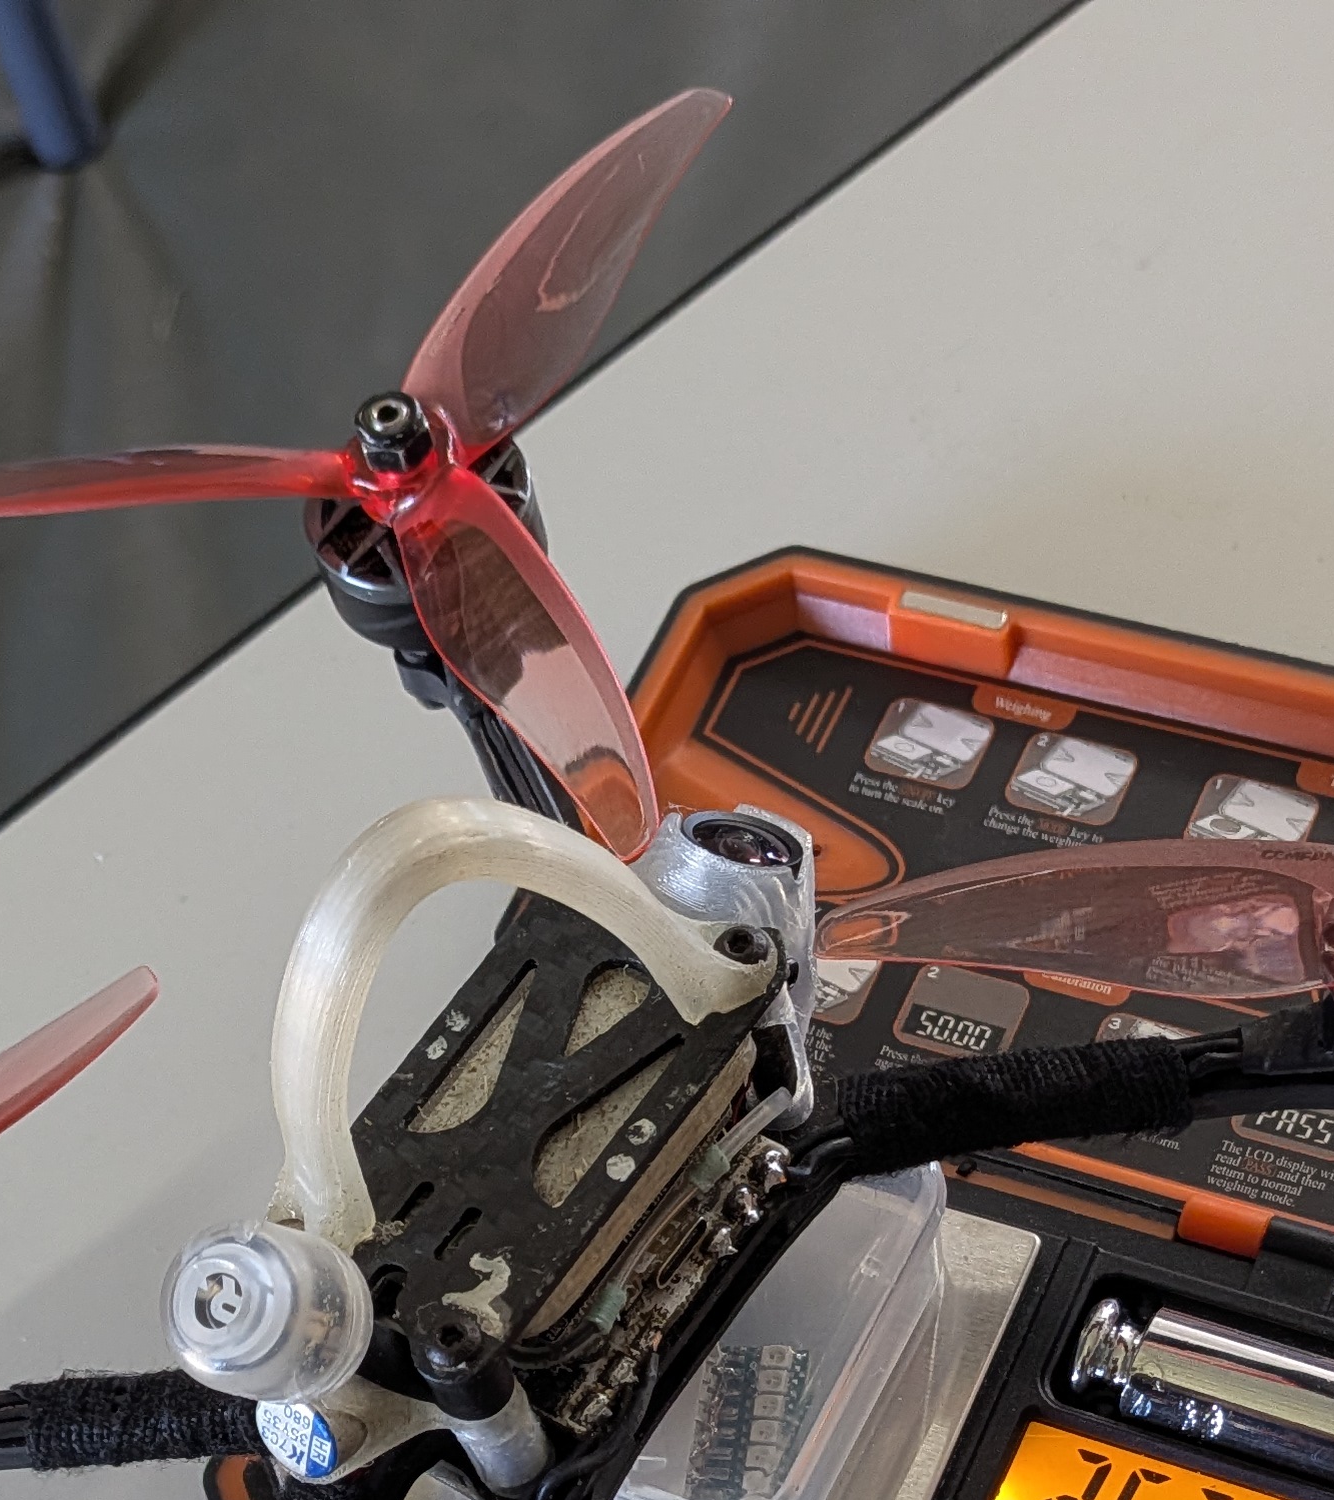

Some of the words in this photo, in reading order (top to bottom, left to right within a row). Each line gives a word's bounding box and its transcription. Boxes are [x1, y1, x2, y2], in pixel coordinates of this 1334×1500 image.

[995, 696, 1052, 722] Weighing
[1037, 735, 1050, 747] 2
[1216, 779, 1223, 790] 1
[983, 817, 1020, 836] change
[1022, 825, 1039, 840] the
[988, 804, 1016, 821] Press
[1017, 813, 1034, 827] the
[1069, 826, 1089, 841] key
[927, 965, 940, 979] 2
[915, 1010, 992, 1051] 50.00
[1108, 1017, 1122, 1030] 3
[880, 1045, 909, 1062] Press
[1221, 1139, 1243, 1155] The
[1245, 1146, 1275, 1163] LCD
[1276, 1156, 1318, 1176] display
[1209, 1163, 1245, 1181] return
[1247, 1172, 1259, 1185] to
[1260, 1178, 1303, 1197] normal
[1214, 1152, 1242, 1167] read
[1243, 1160, 1274, 1178] PASS
[1277, 1171, 1300, 1184] and
[1300, 1174, 1327, 1191] then
[1207, 1174, 1259, 1199] weighing
[1260, 1189, 1296, 1208] mode.
[283, 1404, 311, 1430] 680
[311, 1436, 329, 1464] HR
